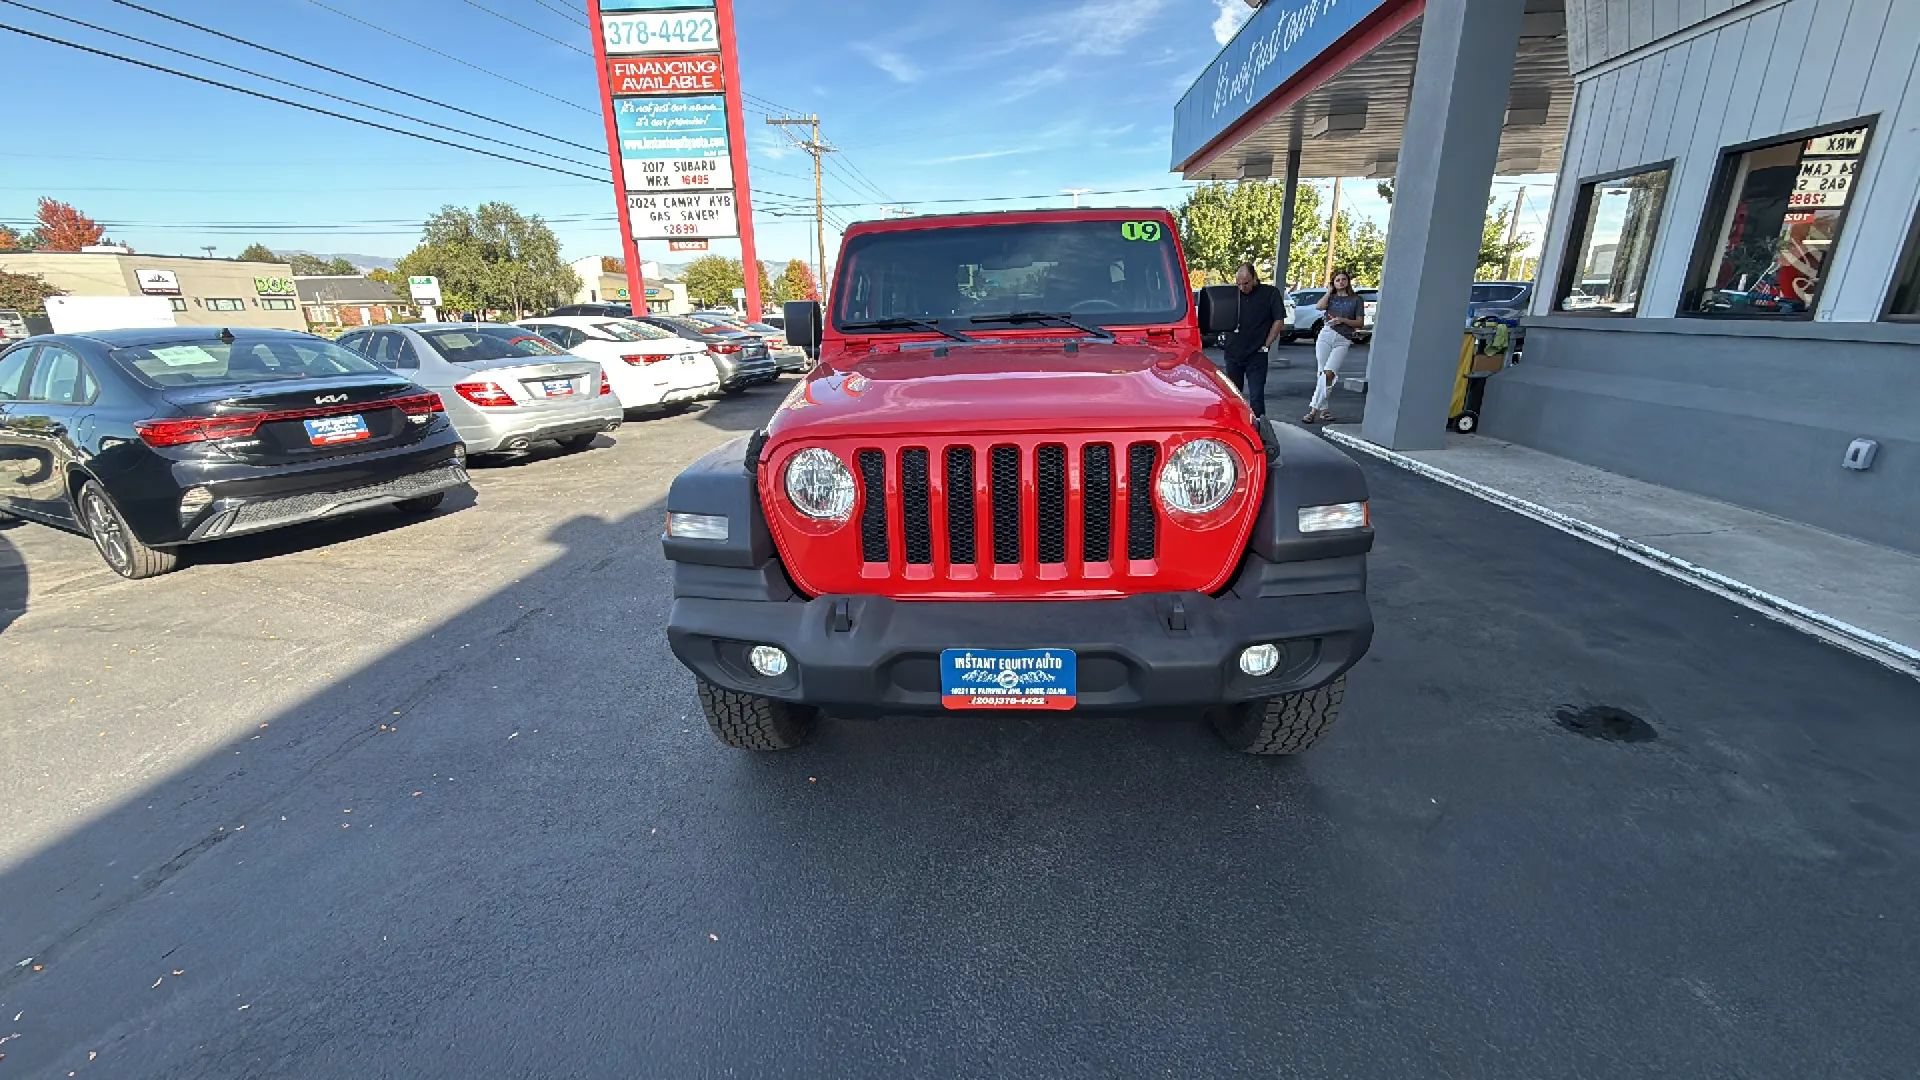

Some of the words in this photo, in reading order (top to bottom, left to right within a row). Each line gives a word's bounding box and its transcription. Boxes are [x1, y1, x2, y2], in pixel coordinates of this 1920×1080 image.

[607, 18, 714, 45] 378-4422
[614, 60, 718, 77] FINANCING
[622, 75, 714, 91] AVAILABLE
[641, 161, 665, 173] 2017
[674, 160, 716, 172] SUBARU
[646, 175, 670, 187] WRX
[681, 174, 709, 186] 16495
[629, 197, 657, 209] 2024
[663, 196, 701, 208] CAMRY
[650, 211, 670, 221] GAS
[680, 209, 720, 221] SAVER!
[1124, 222, 1159, 240] 19
[954, 657, 997, 669] INSTANT
[998, 657, 1035, 670] EQUITY
[1035, 657, 1063, 669] AUTO
